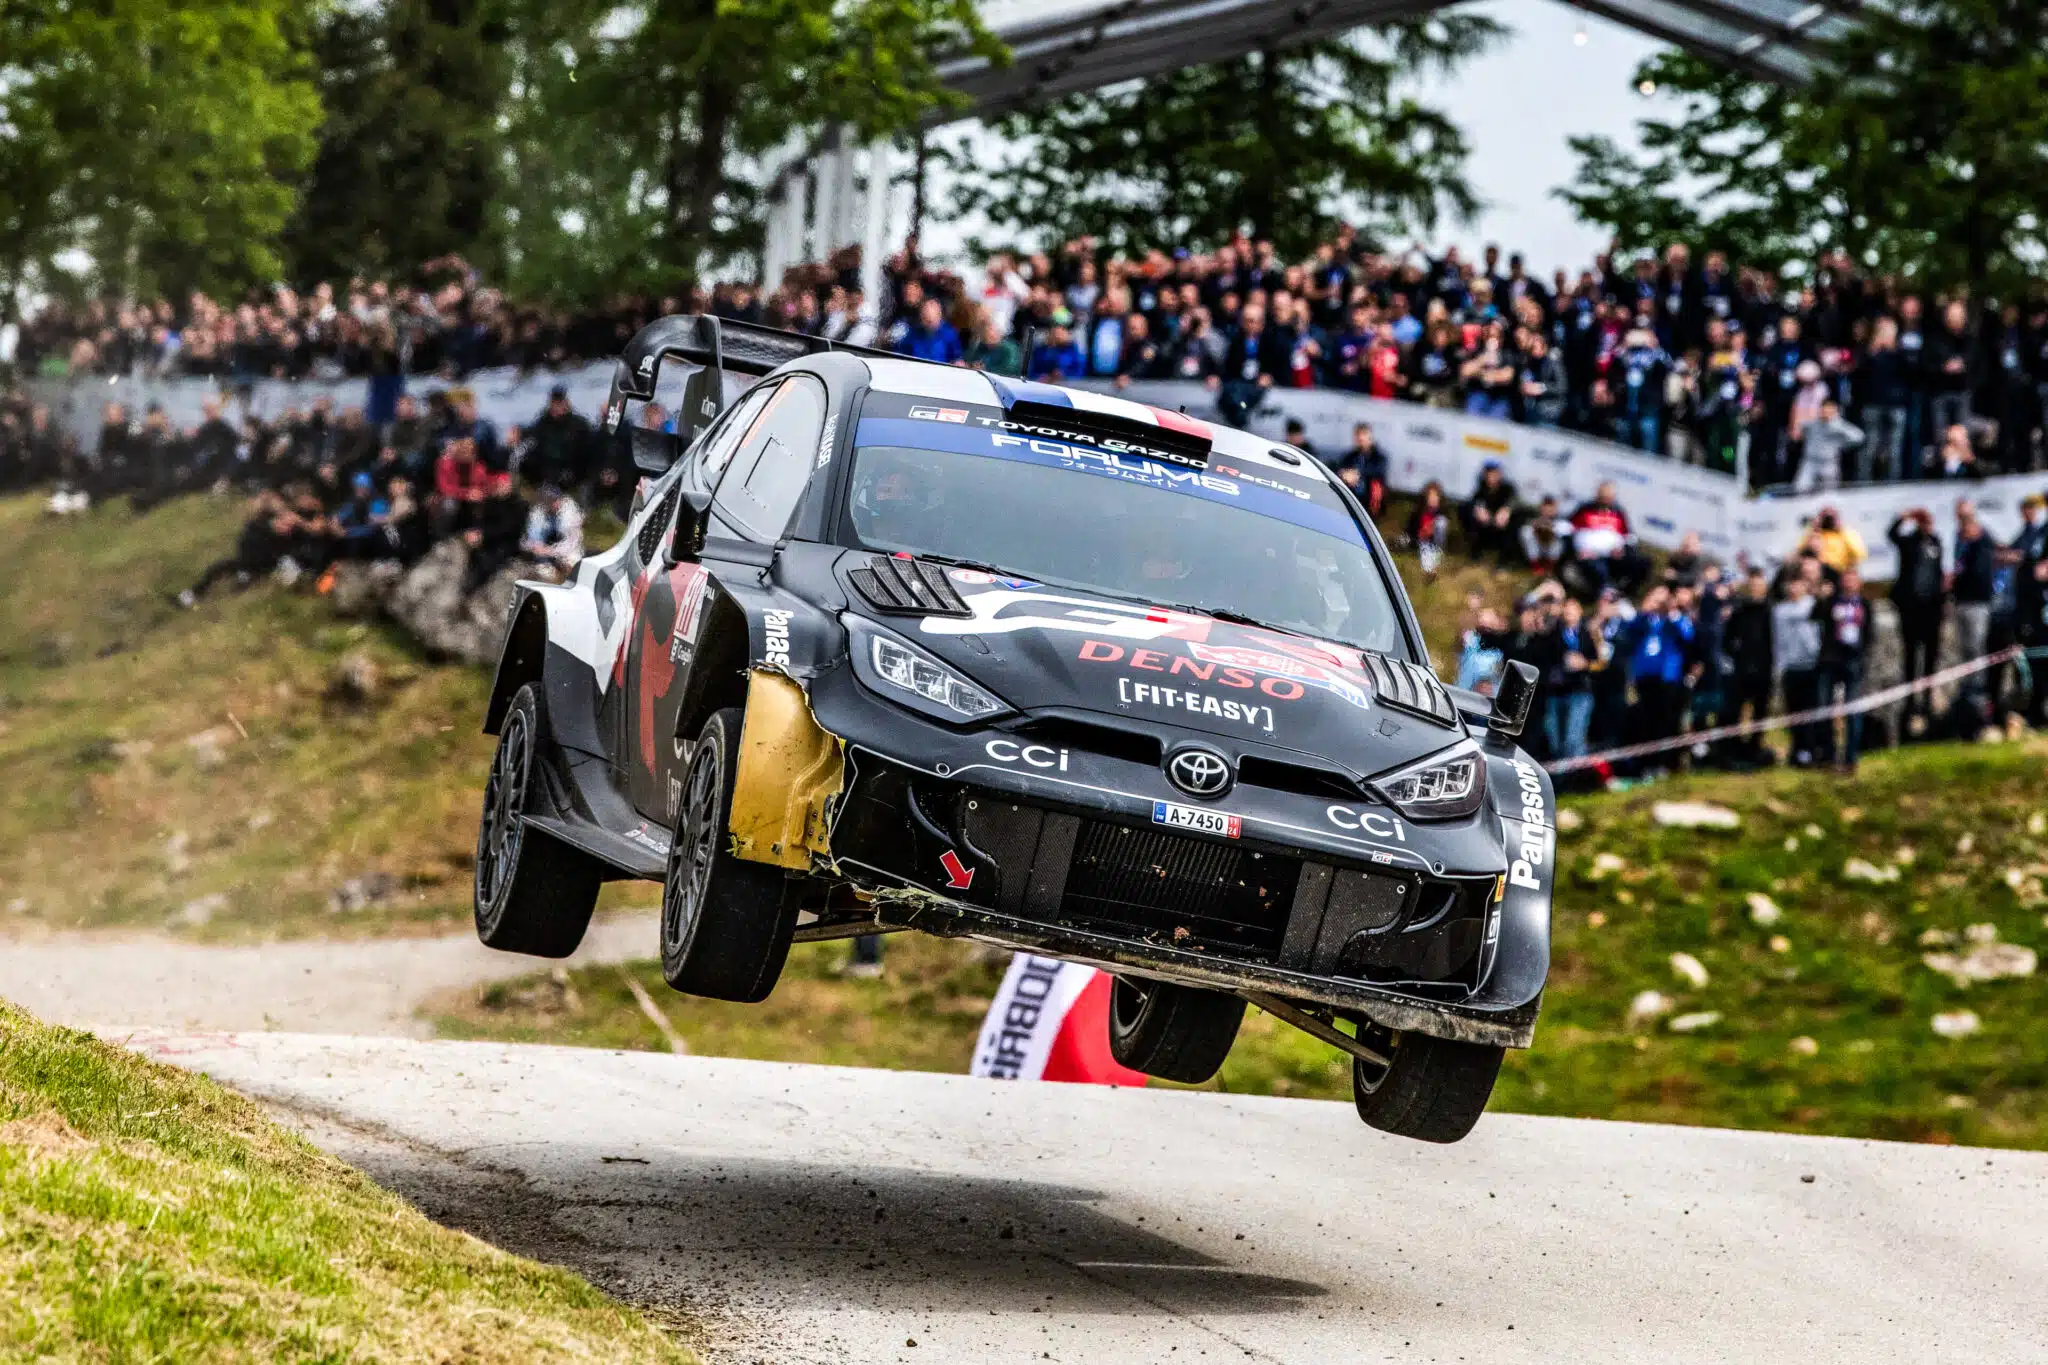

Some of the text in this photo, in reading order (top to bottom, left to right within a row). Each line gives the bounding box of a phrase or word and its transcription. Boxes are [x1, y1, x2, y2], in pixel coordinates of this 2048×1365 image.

[975, 416, 1312, 501] TOYOTA GAZOO Racing
[990, 433, 1240, 497] FORUM8
[1078, 639, 1305, 701] DENSO
[1169, 807, 1224, 832] A-7450
[1228, 827, 1237, 836] 24
